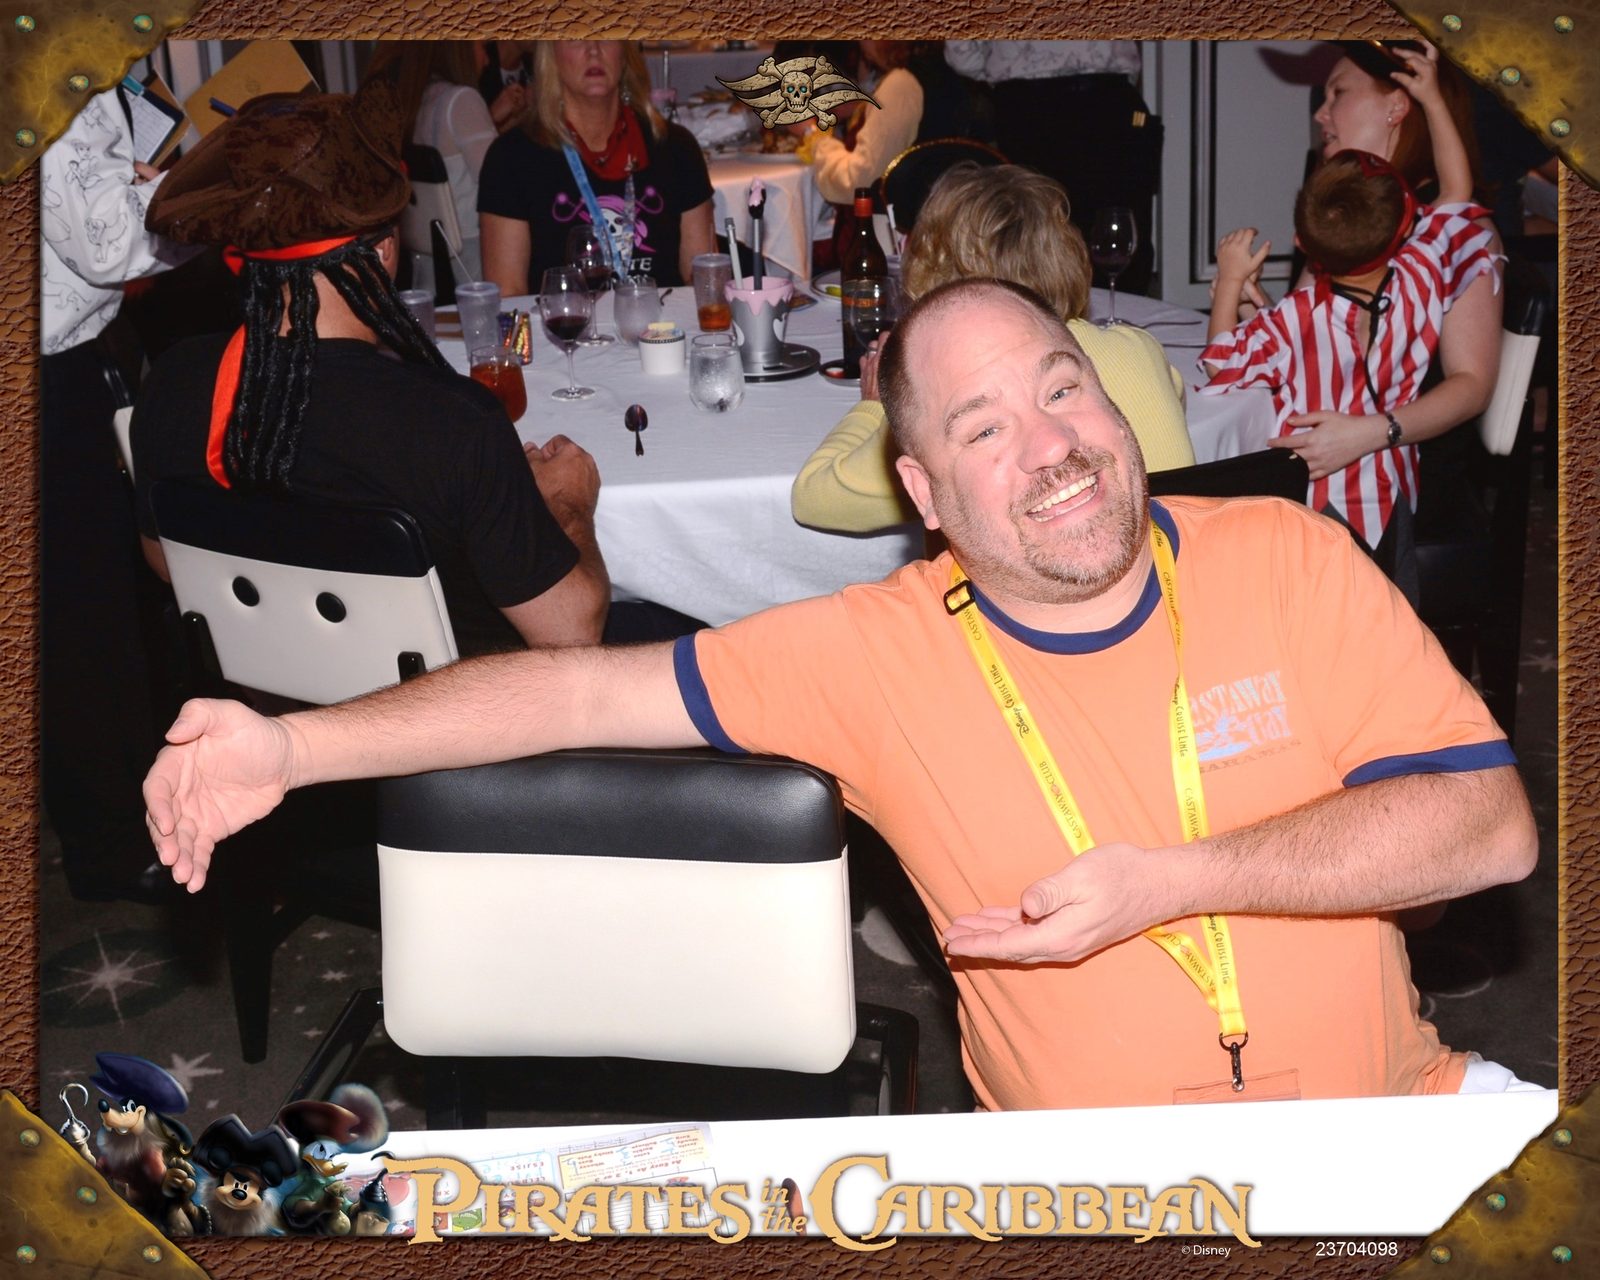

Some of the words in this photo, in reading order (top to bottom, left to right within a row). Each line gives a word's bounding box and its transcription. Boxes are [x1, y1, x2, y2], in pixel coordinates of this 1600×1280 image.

[962, 606, 983, 641] CASTAW
[1040, 761, 1055, 785] CLUB
[1055, 793, 1082, 839] CASTAWAY
[1185, 787, 1200, 839] CASTAWAY
[1163, 933, 1181, 946] CLU
